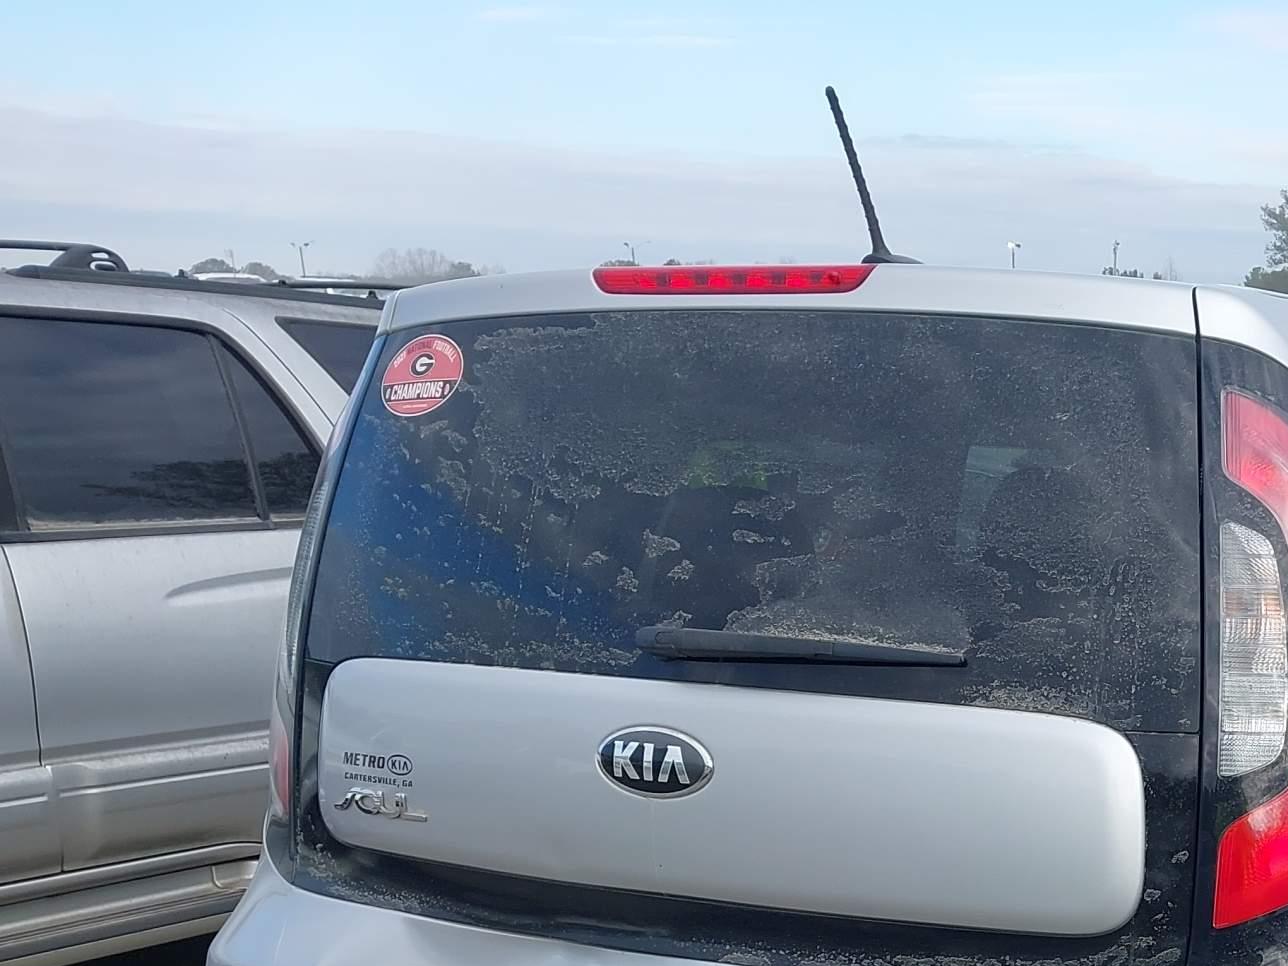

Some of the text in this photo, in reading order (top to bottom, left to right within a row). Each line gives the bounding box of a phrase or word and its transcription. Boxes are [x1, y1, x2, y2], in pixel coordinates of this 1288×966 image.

[432, 340, 456, 363] FOOTBALL
[391, 381, 443, 399] CHAMPIONS
[343, 752, 409, 771] METRO KIA
[612, 740, 690, 785] KIA
[345, 772, 399, 787] CARTERSVILLE,
[334, 788, 427, 822] SOUL
